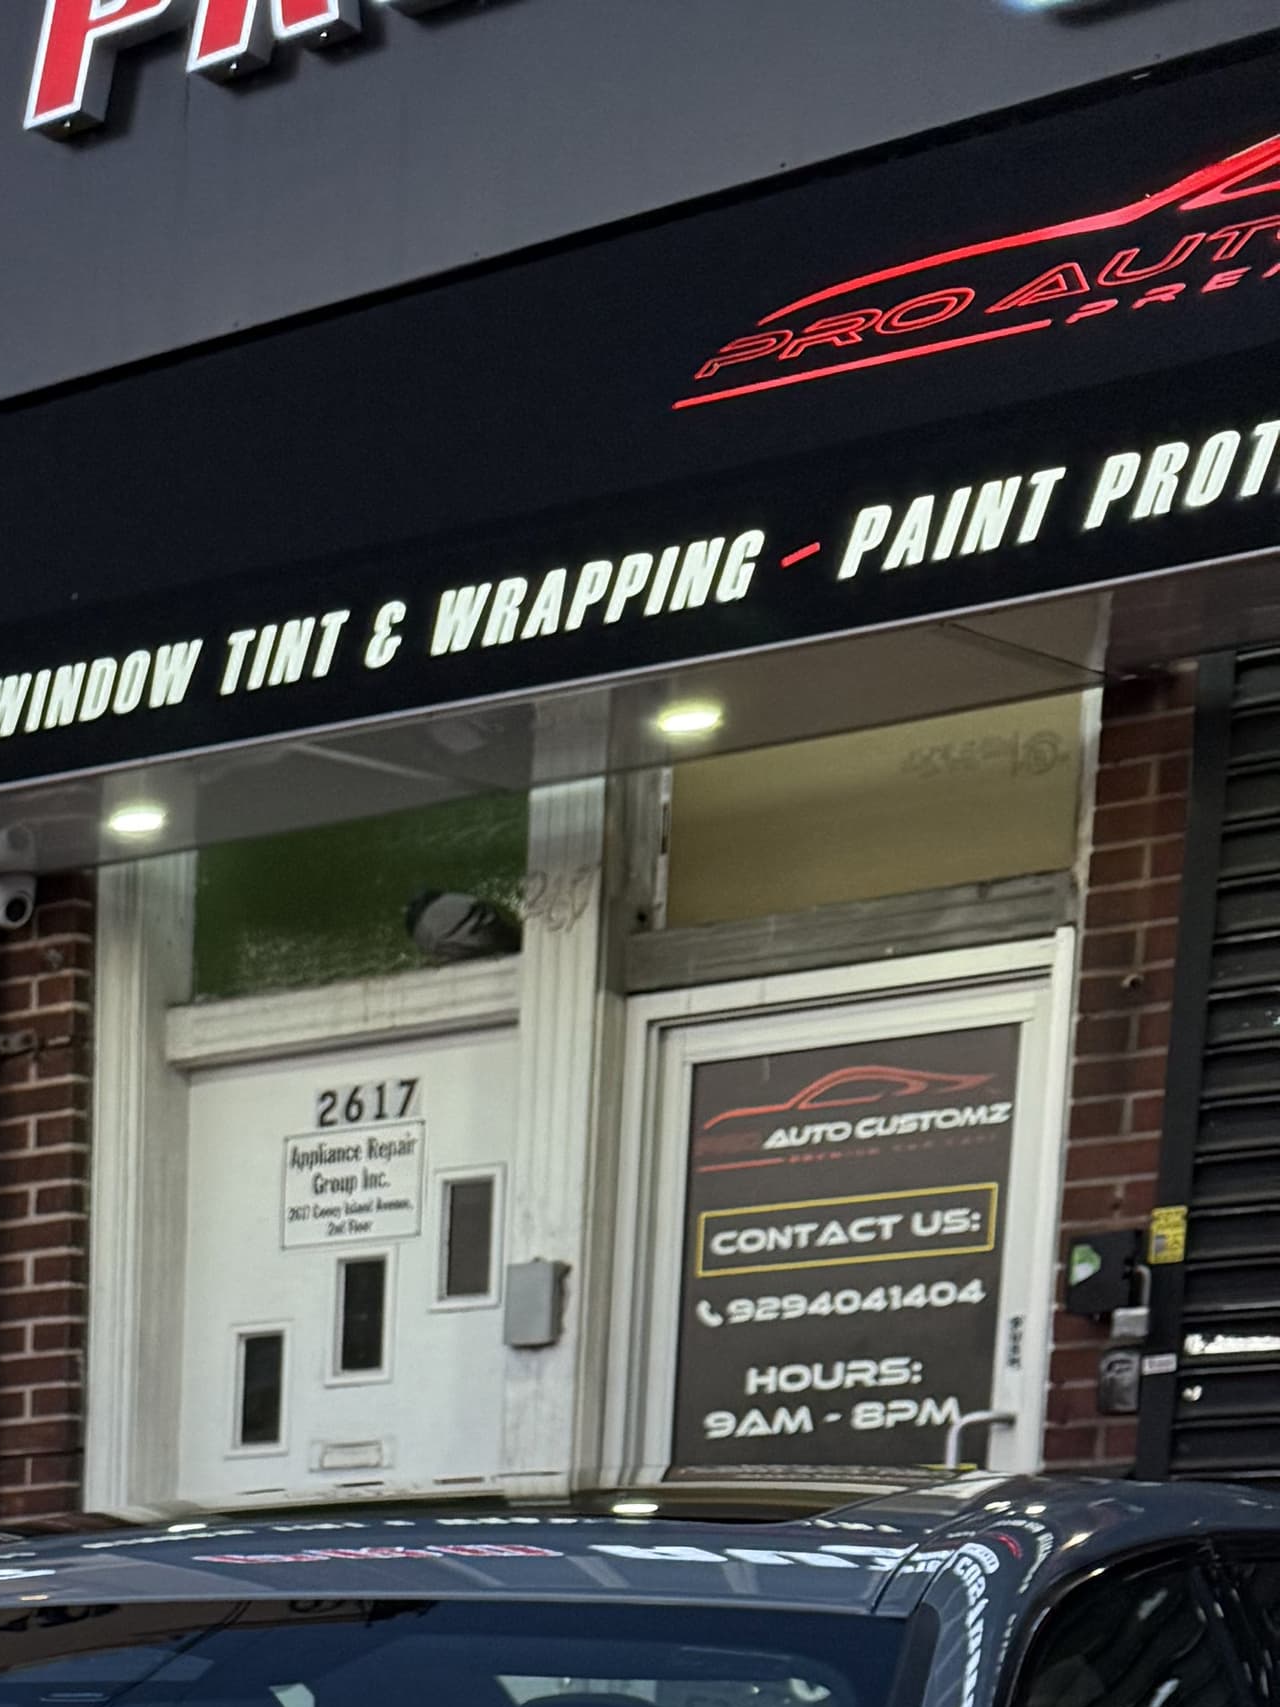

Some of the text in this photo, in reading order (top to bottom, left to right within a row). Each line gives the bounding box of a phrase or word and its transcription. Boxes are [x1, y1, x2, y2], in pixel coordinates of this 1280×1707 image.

[694, 215, 1280, 380] PRO AUT
[1065, 264, 1280, 325] PRE
[220, 609, 351, 696] TINT
[363, 601, 404, 670] &
[430, 529, 766, 657] WRAPPING
[838, 466, 1067, 580] PAINT
[317, 1077, 420, 1129] 2617
[762, 1121, 852, 1150] AUTO
[854, 1101, 1013, 1141] CUSTOMZ
[290, 1132, 418, 1171] Appliance Repair
[313, 1166, 392, 1195] Group Inc.
[348, 1218, 375, 1233] Floor
[710, 1207, 983, 1257] CONTACT US:
[727, 1279, 987, 1325] 9294041404
[744, 1356, 924, 1396] HOURS:
[702, 1405, 815, 1440] 9AM
[851, 1396, 962, 1431] 8PM
